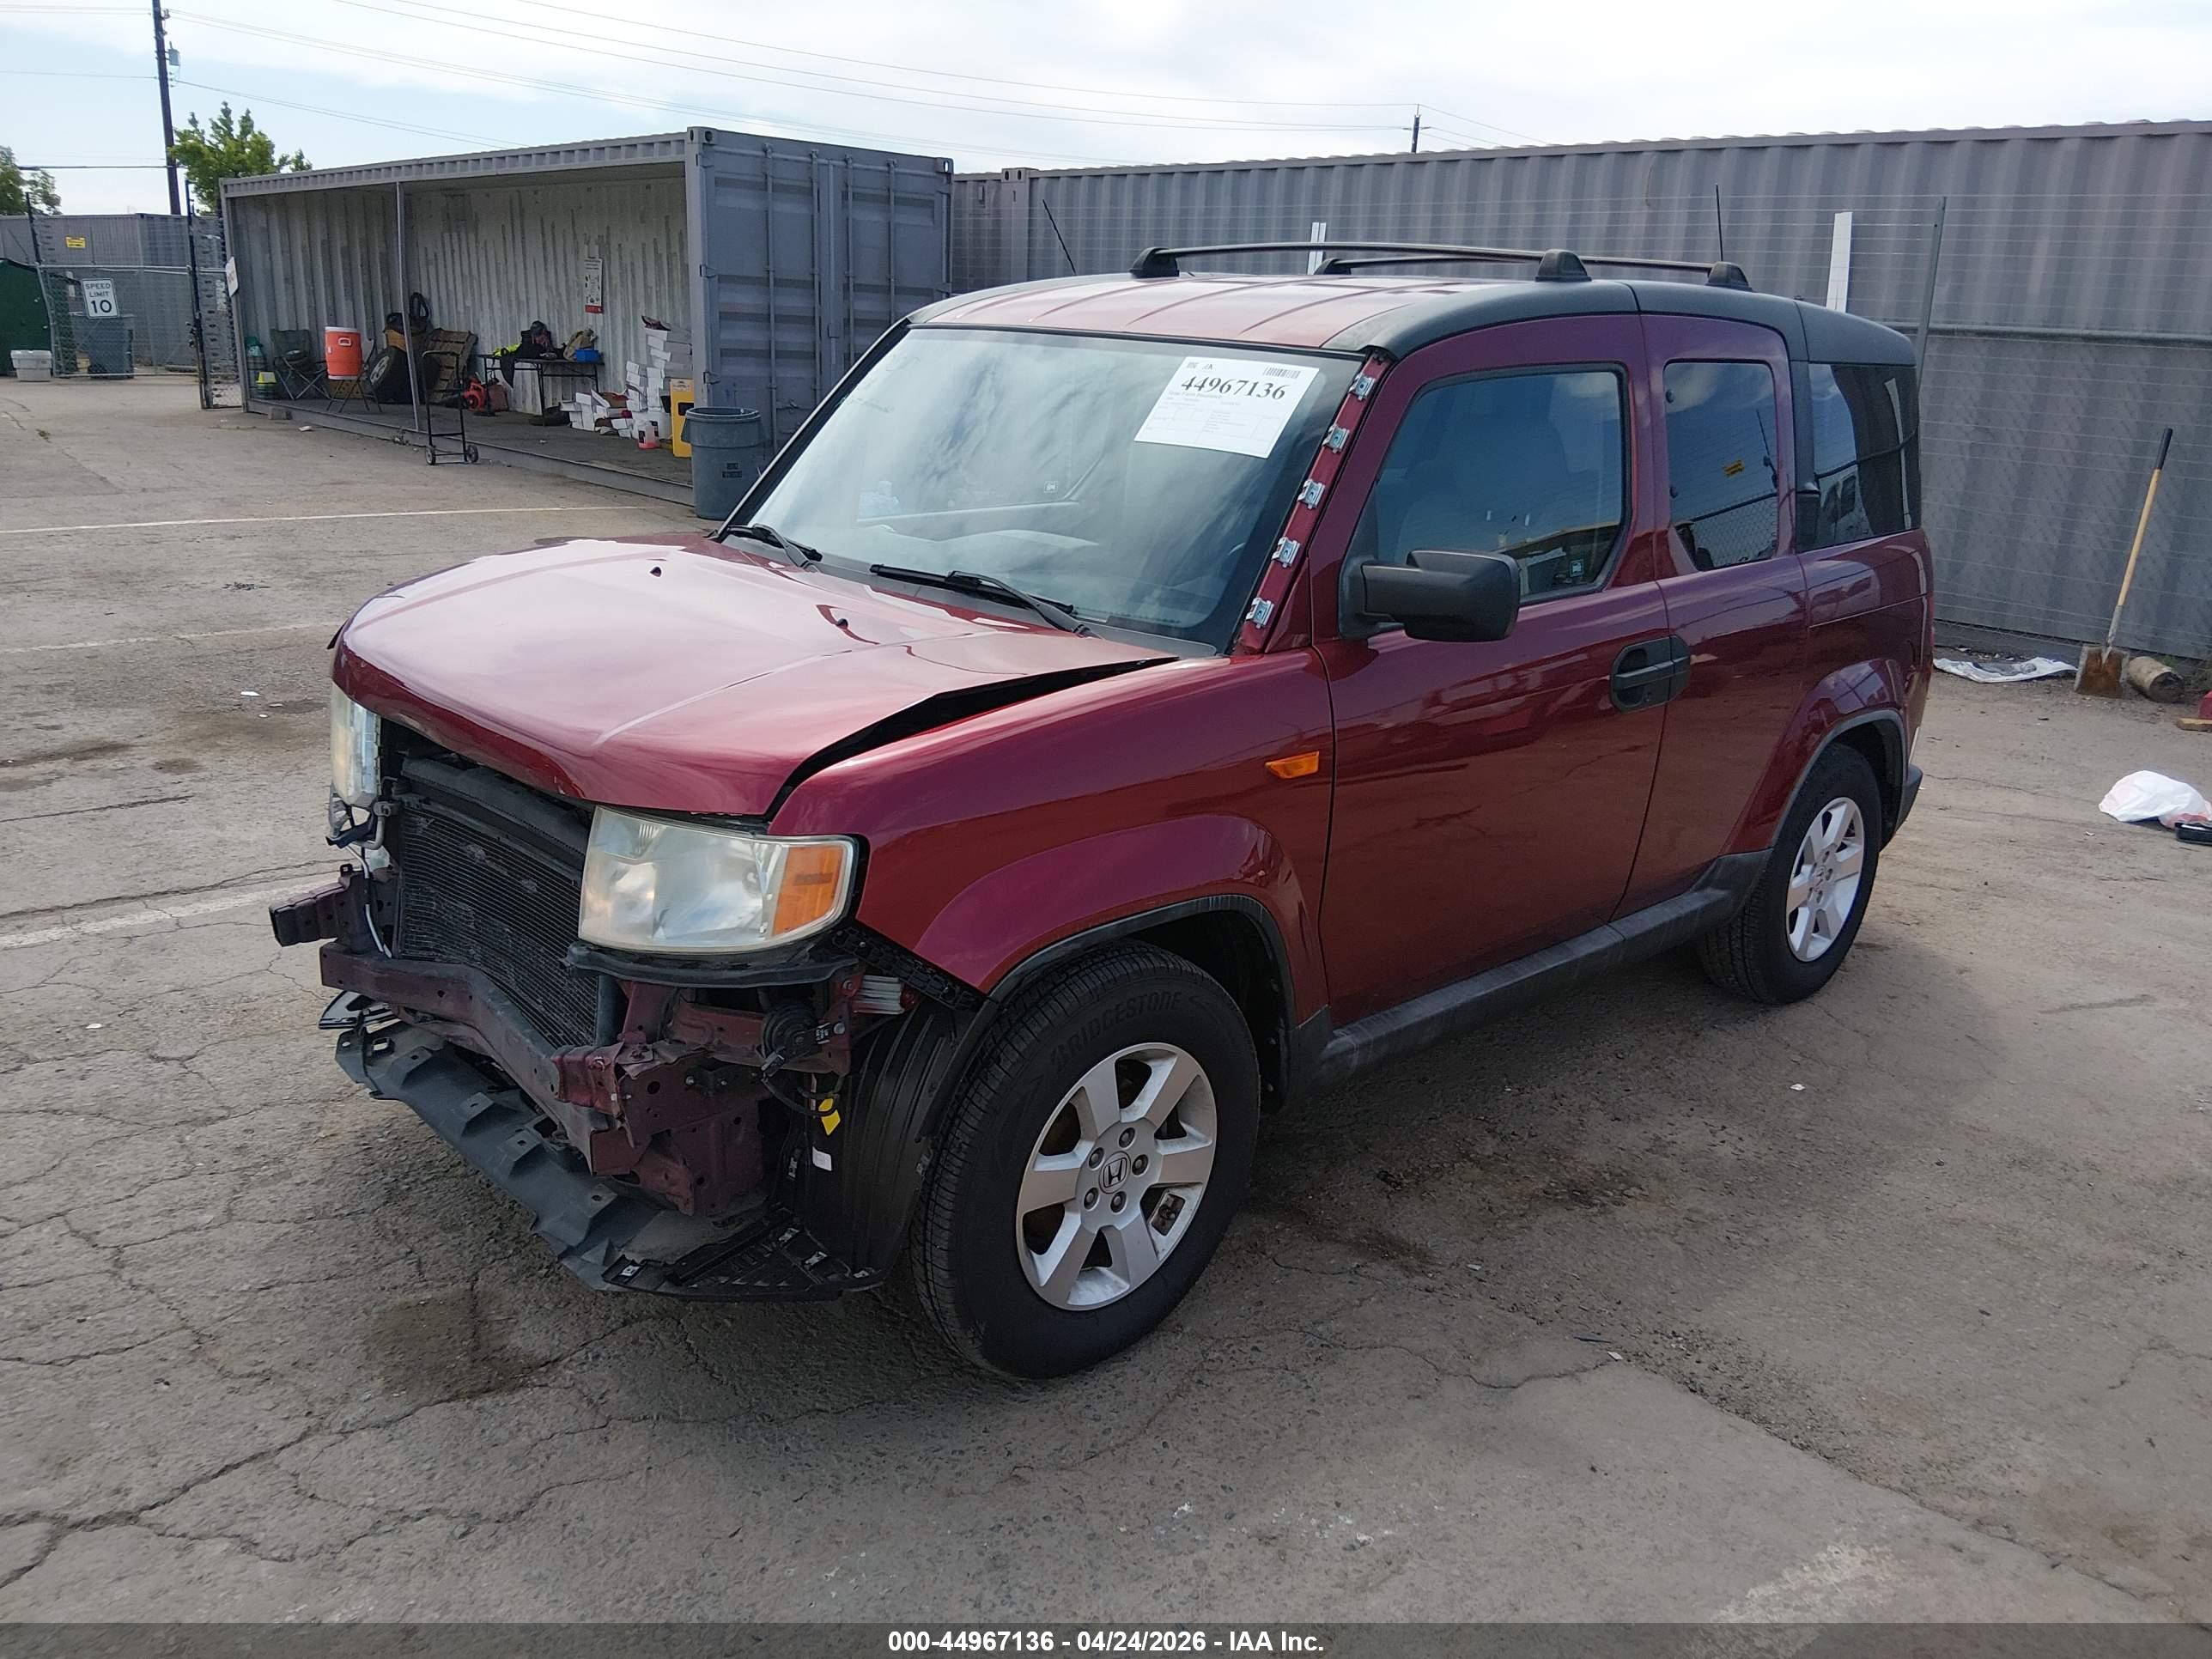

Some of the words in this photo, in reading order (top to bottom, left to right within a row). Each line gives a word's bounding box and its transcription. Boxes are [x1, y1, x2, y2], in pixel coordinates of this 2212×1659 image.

[91, 300, 112, 313] 10
[1181, 375, 1291, 400] 44967136
[1049, 991, 1182, 1073] BRIDGESTONE
